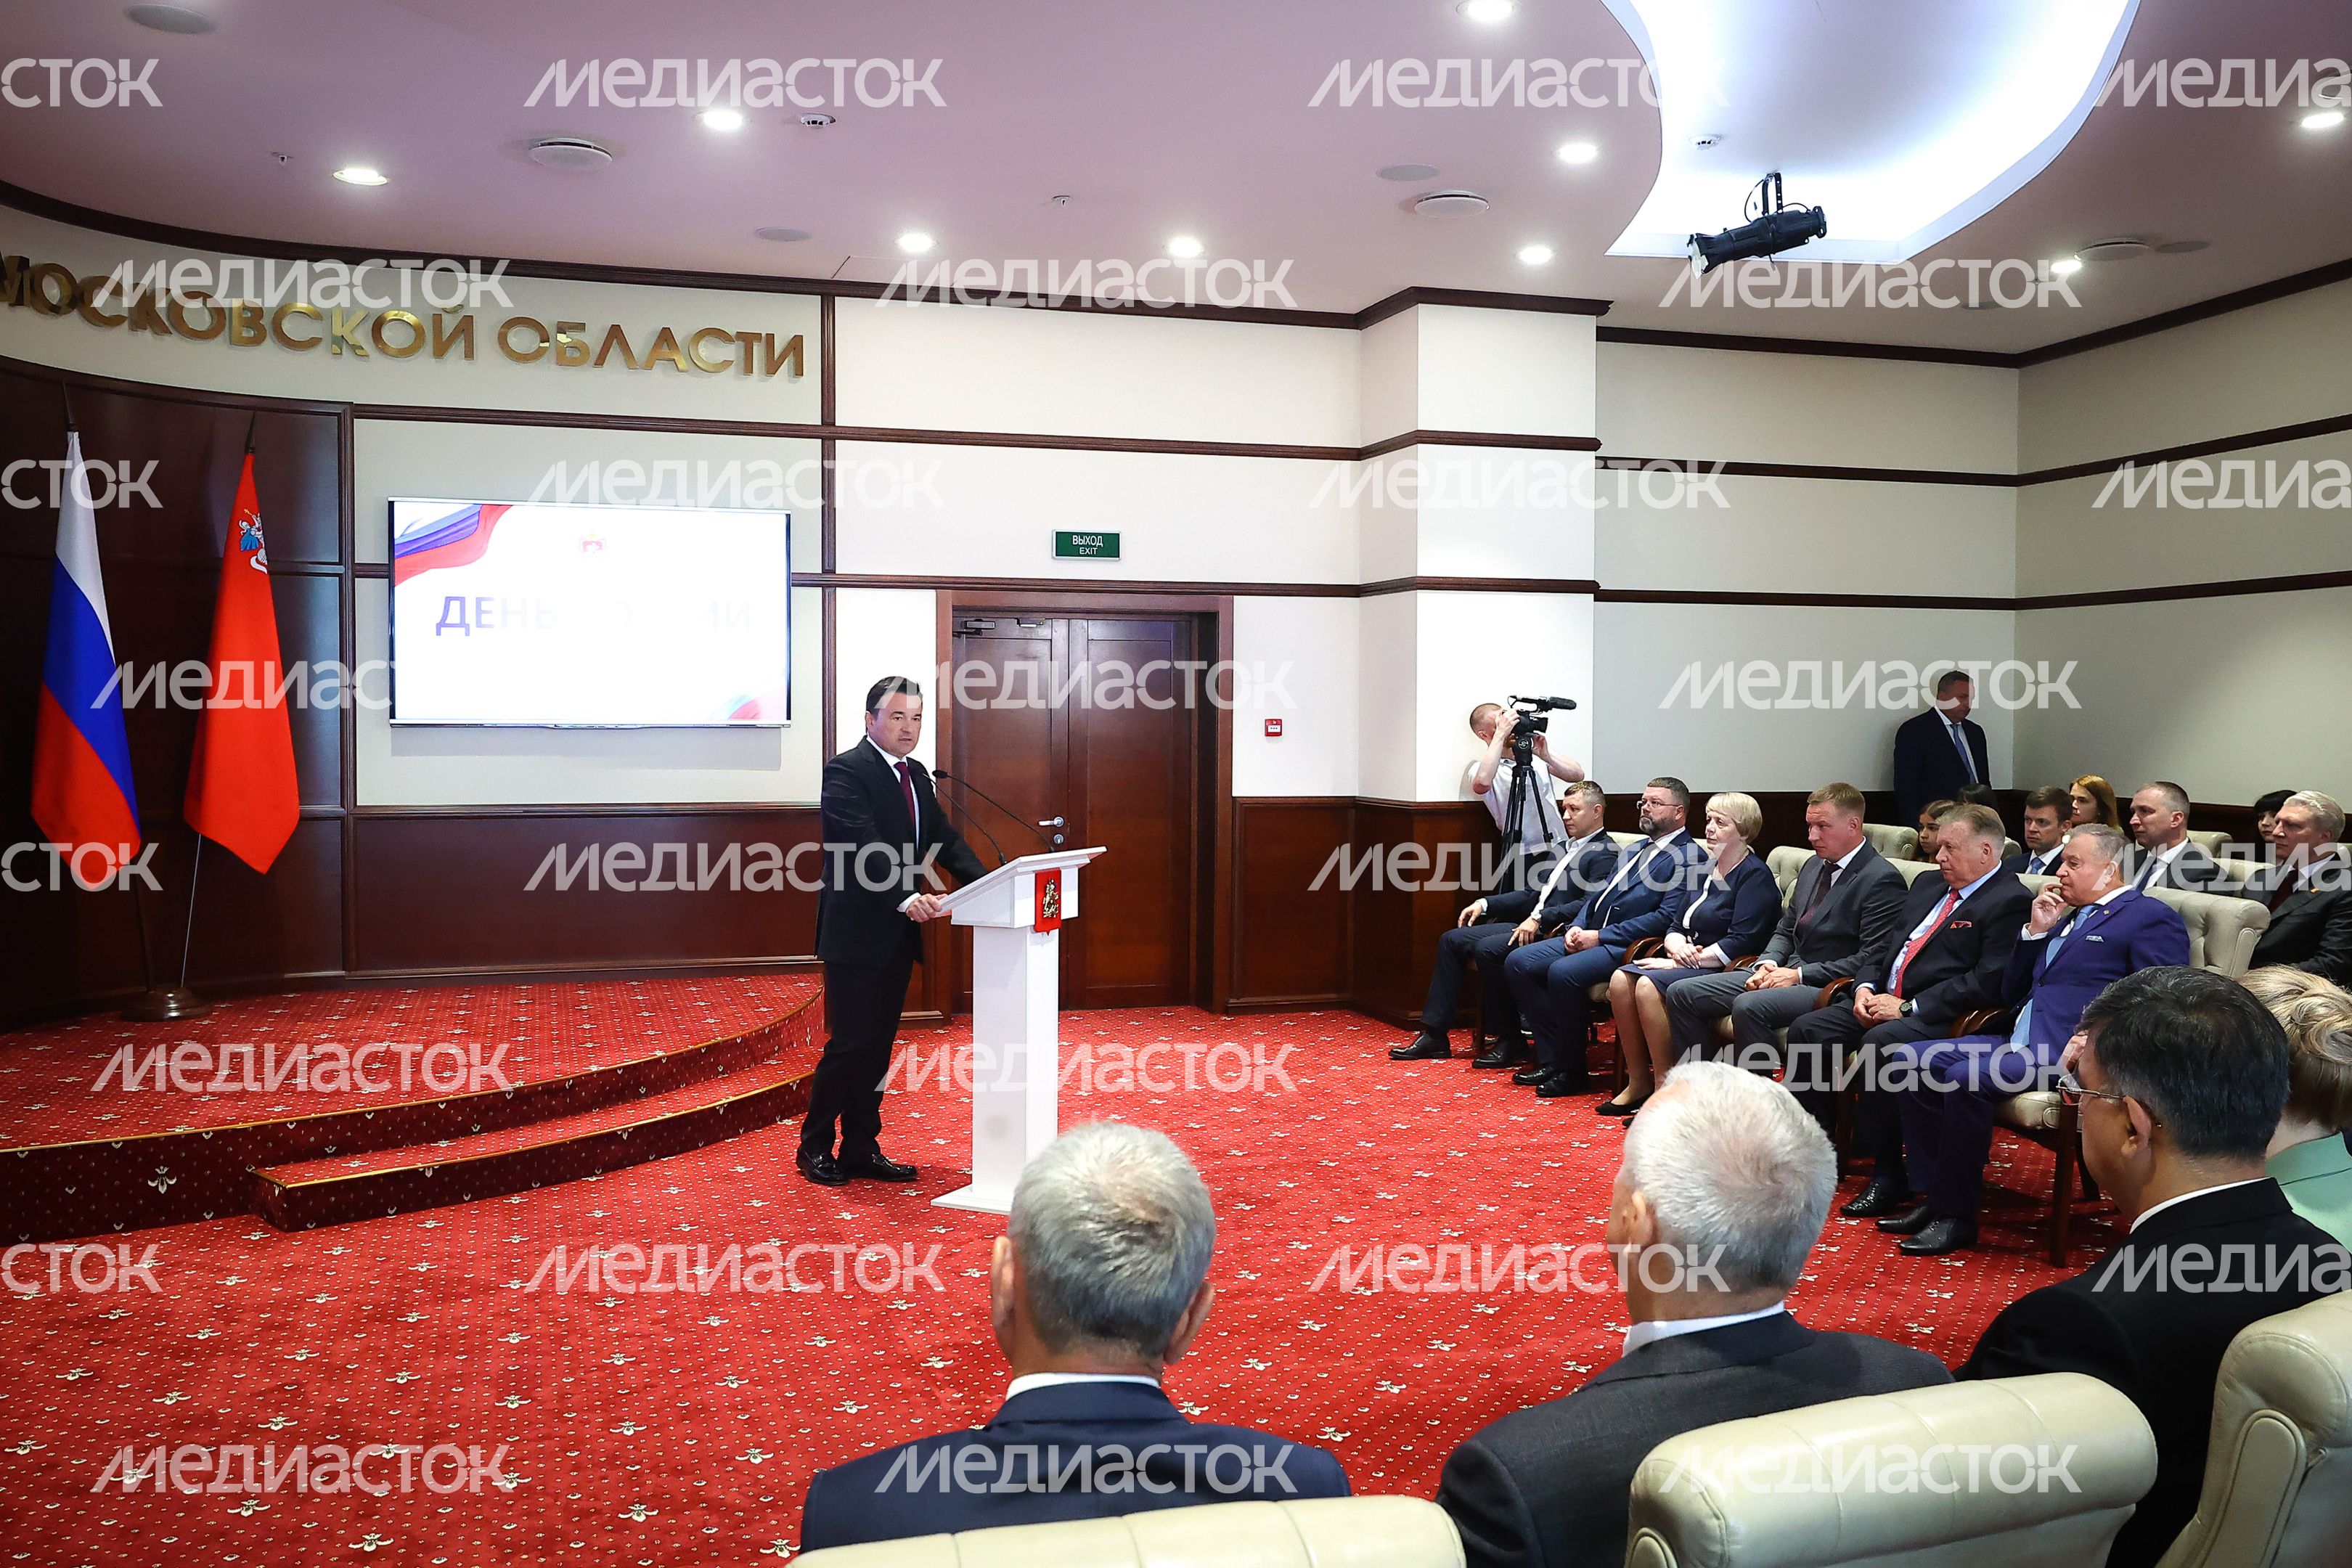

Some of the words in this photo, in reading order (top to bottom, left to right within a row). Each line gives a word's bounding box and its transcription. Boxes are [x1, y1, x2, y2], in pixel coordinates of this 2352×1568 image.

[497, 317, 804, 378] ОБЛАСТИ
[1072, 535, 1103, 547] ВЫХОД
[436, 596, 559, 637] ДЕНЬ
